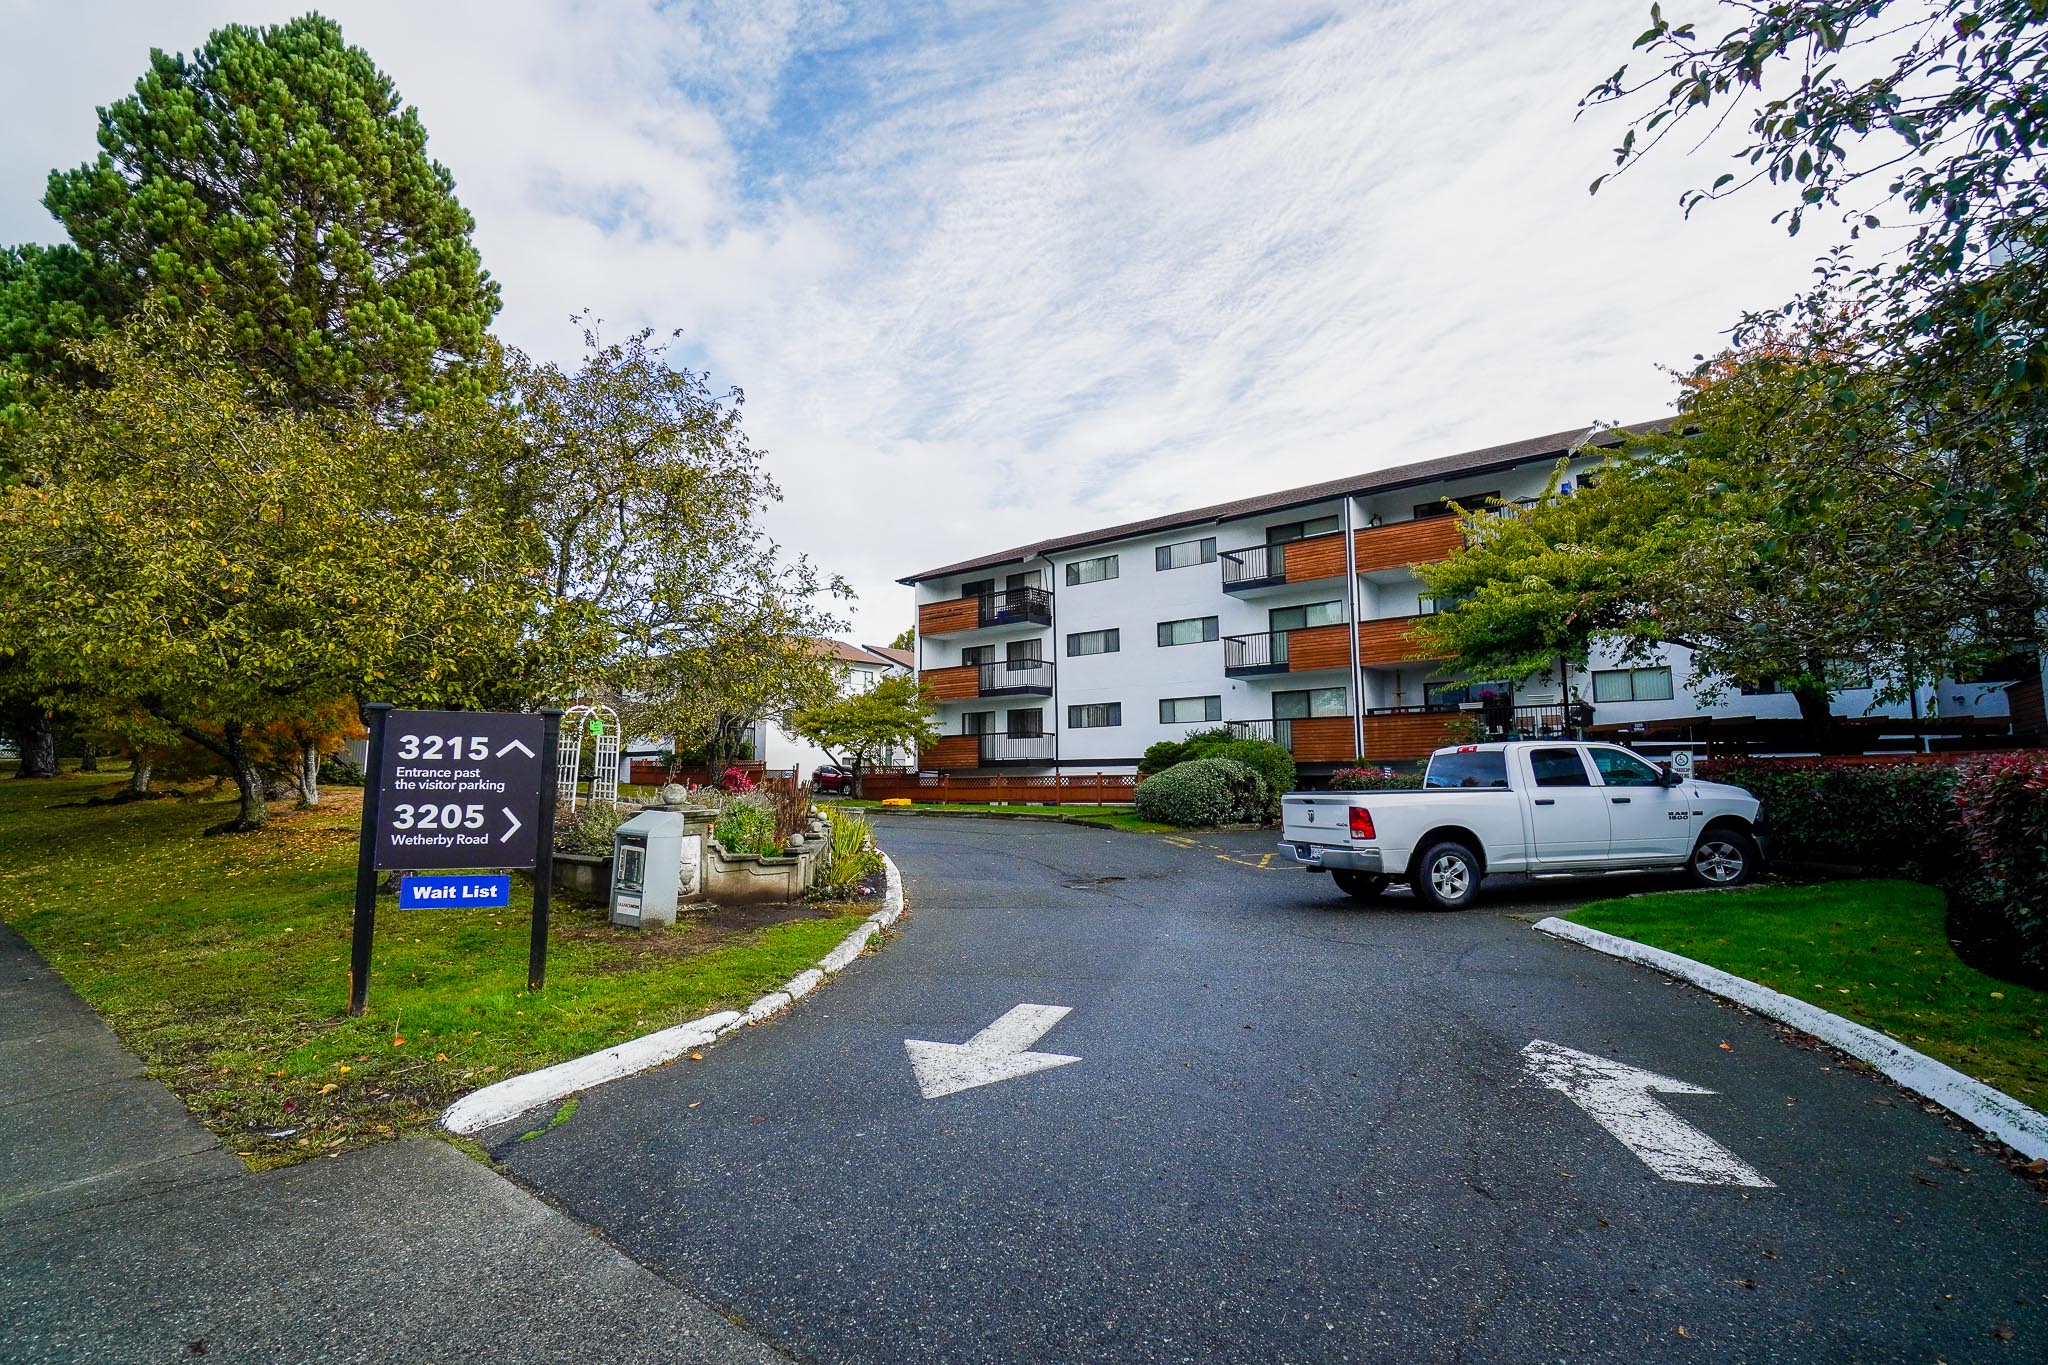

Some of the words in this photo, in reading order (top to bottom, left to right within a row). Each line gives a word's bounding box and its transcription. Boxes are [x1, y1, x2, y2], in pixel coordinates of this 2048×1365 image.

[397, 734, 489, 761] 3215
[396, 766, 452, 778] Entrance
[453, 768, 481, 780] past
[394, 778, 416, 790] the
[418, 779, 457, 790] visitor
[458, 779, 506, 793] parking
[392, 803, 485, 829] 3205
[391, 833, 455, 848] Wetherby
[456, 833, 489, 845] Road
[413, 886, 457, 900] Wait
[462, 885, 498, 898] List
